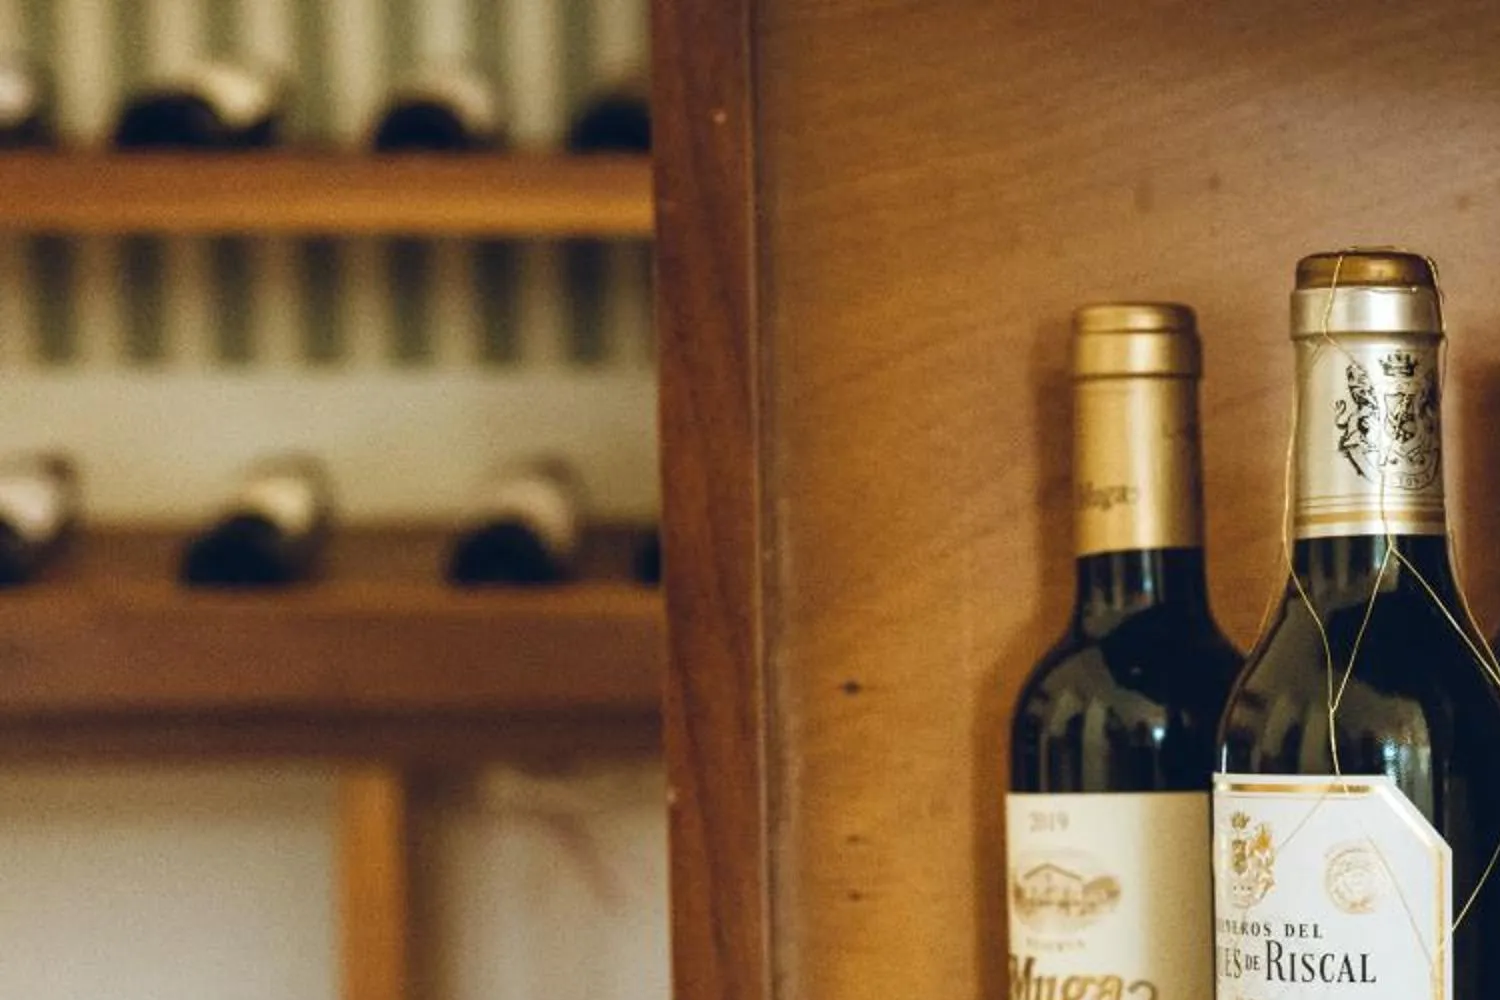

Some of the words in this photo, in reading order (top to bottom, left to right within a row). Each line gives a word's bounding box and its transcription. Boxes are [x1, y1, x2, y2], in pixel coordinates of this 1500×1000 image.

[1284, 922, 1323, 939] DEL
[1244, 954, 1261, 971] DE
[1265, 939, 1378, 984] RISCAL
